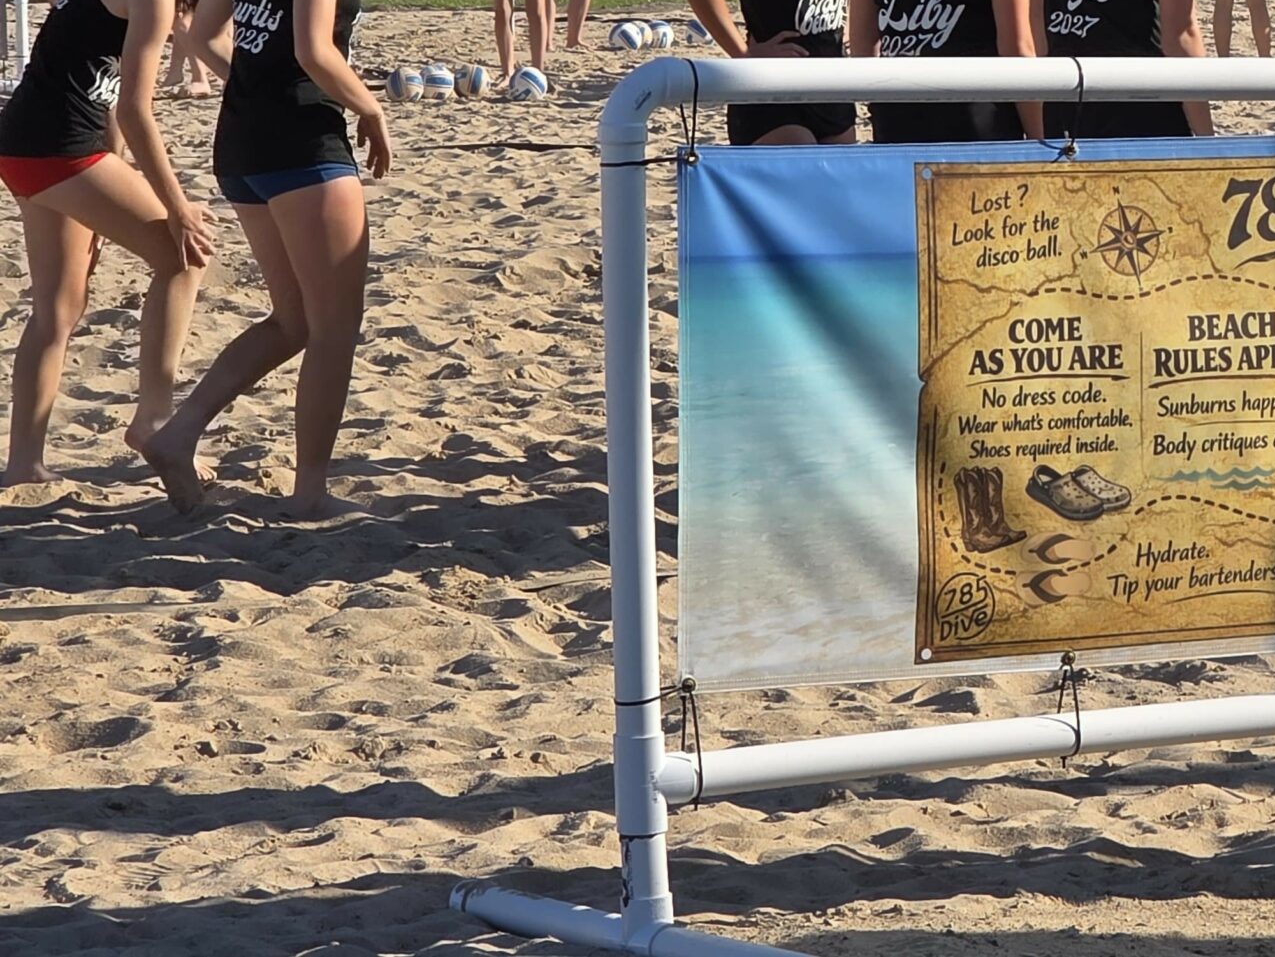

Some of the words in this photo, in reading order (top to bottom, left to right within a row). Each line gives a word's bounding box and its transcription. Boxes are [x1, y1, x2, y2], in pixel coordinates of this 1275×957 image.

[1048, 11, 1100, 38] 2027
[234, 25, 270, 54] 028
[952, 221, 996, 246] Look
[1001, 218, 1027, 237] for
[1033, 215, 1060, 233] the
[975, 246, 1020, 269] disco
[1025, 237, 1062, 260] ball.
[1008, 317, 1083, 344] COME
[968, 348, 1004, 376] AS
[1009, 346, 1064, 372] YOU
[1068, 344, 1124, 370] ARE
[1154, 346, 1232, 377] RULES
[981, 388, 1006, 410] No
[1012, 386, 1056, 407] dress
[1062, 382, 1107, 403] code.
[1157, 395, 1237, 417] Sunburns
[958, 416, 997, 434] Wear
[1002, 413, 1044, 432] what's
[1048, 411, 1134, 430] comfortable.
[969, 439, 1011, 459] Shoes
[1016, 438, 1072, 462] required
[1076, 437, 1119, 453] inside.
[1152, 433, 1196, 460] Body
[1201, 432, 1268, 455] critiques
[1136, 542, 1211, 570] Hydrate.
[944, 575, 988, 612] 785
[1106, 574, 1138, 599] Tip
[1144, 574, 1184, 600] your
[940, 604, 988, 642] Dive
